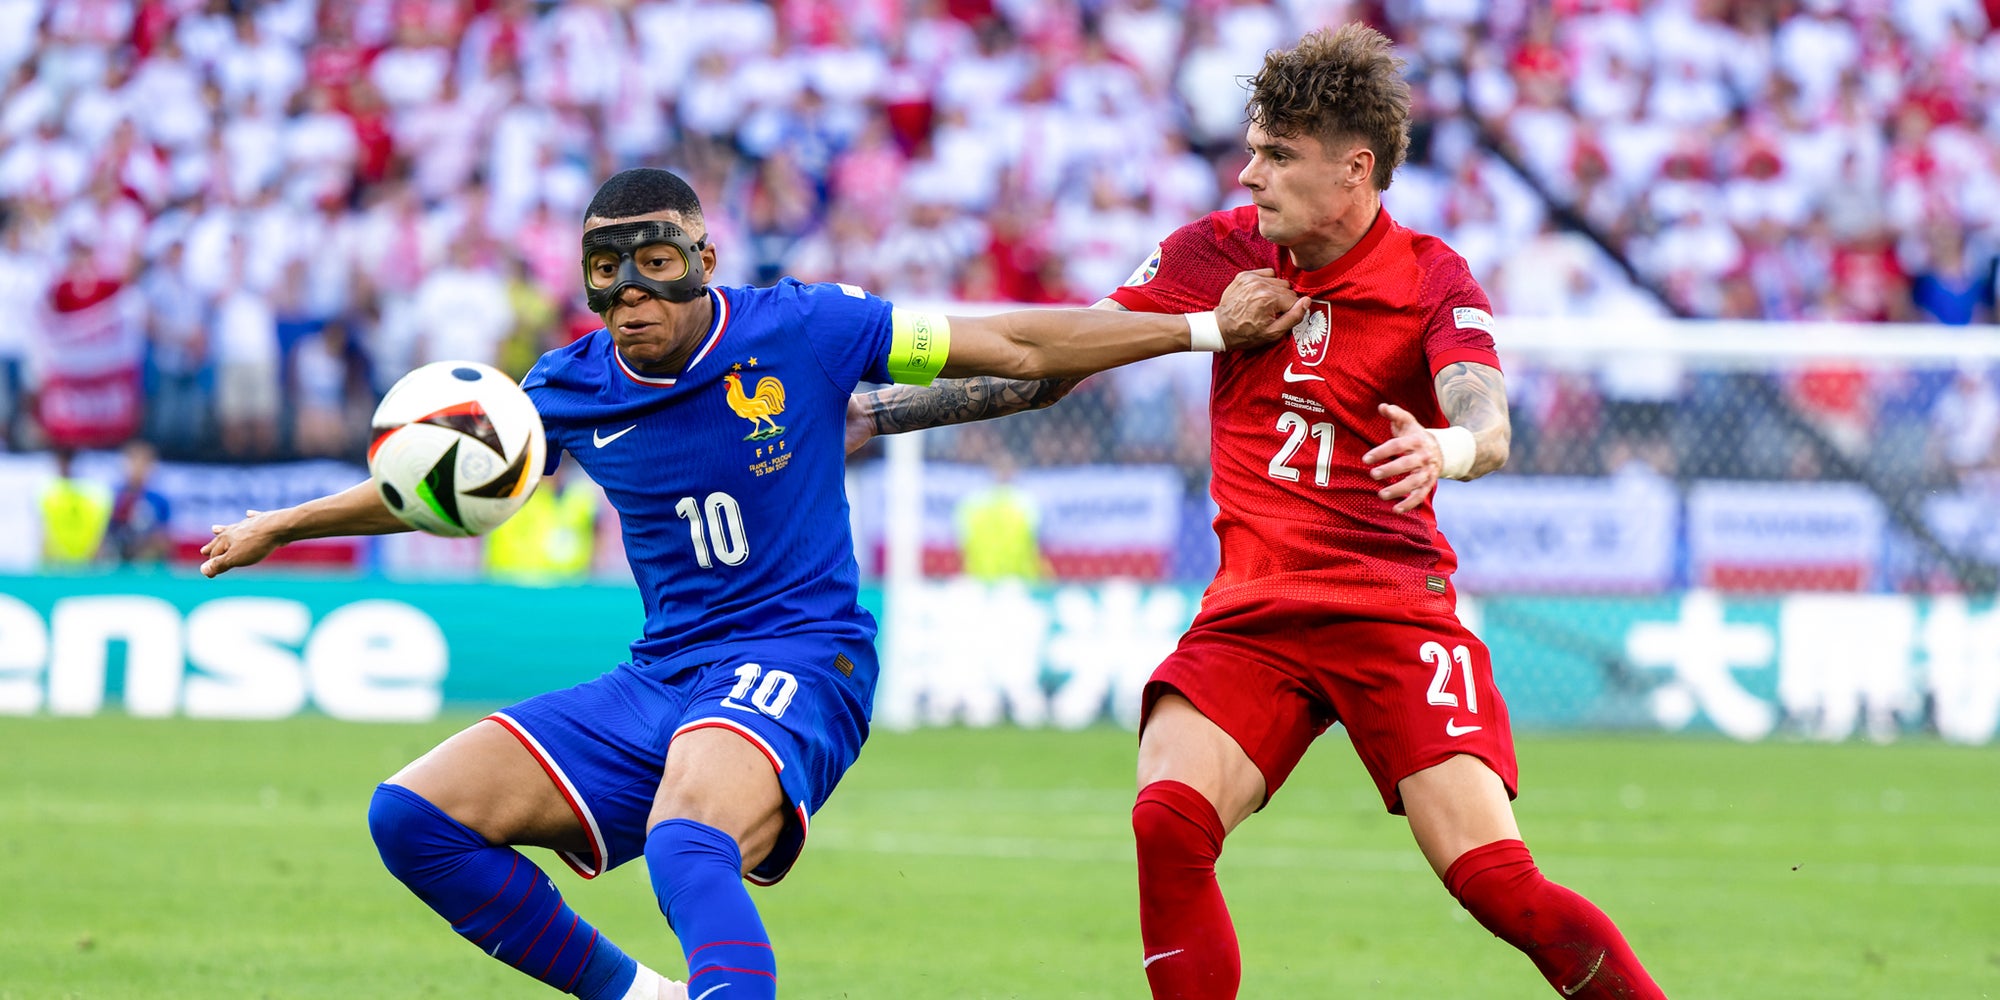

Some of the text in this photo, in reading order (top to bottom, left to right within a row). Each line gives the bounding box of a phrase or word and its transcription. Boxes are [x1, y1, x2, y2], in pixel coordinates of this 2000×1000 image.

[1268, 411, 1335, 487] 21
[675, 491, 749, 569] 10
[728, 663, 798, 719] 10
[1419, 641, 1478, 714] 21
